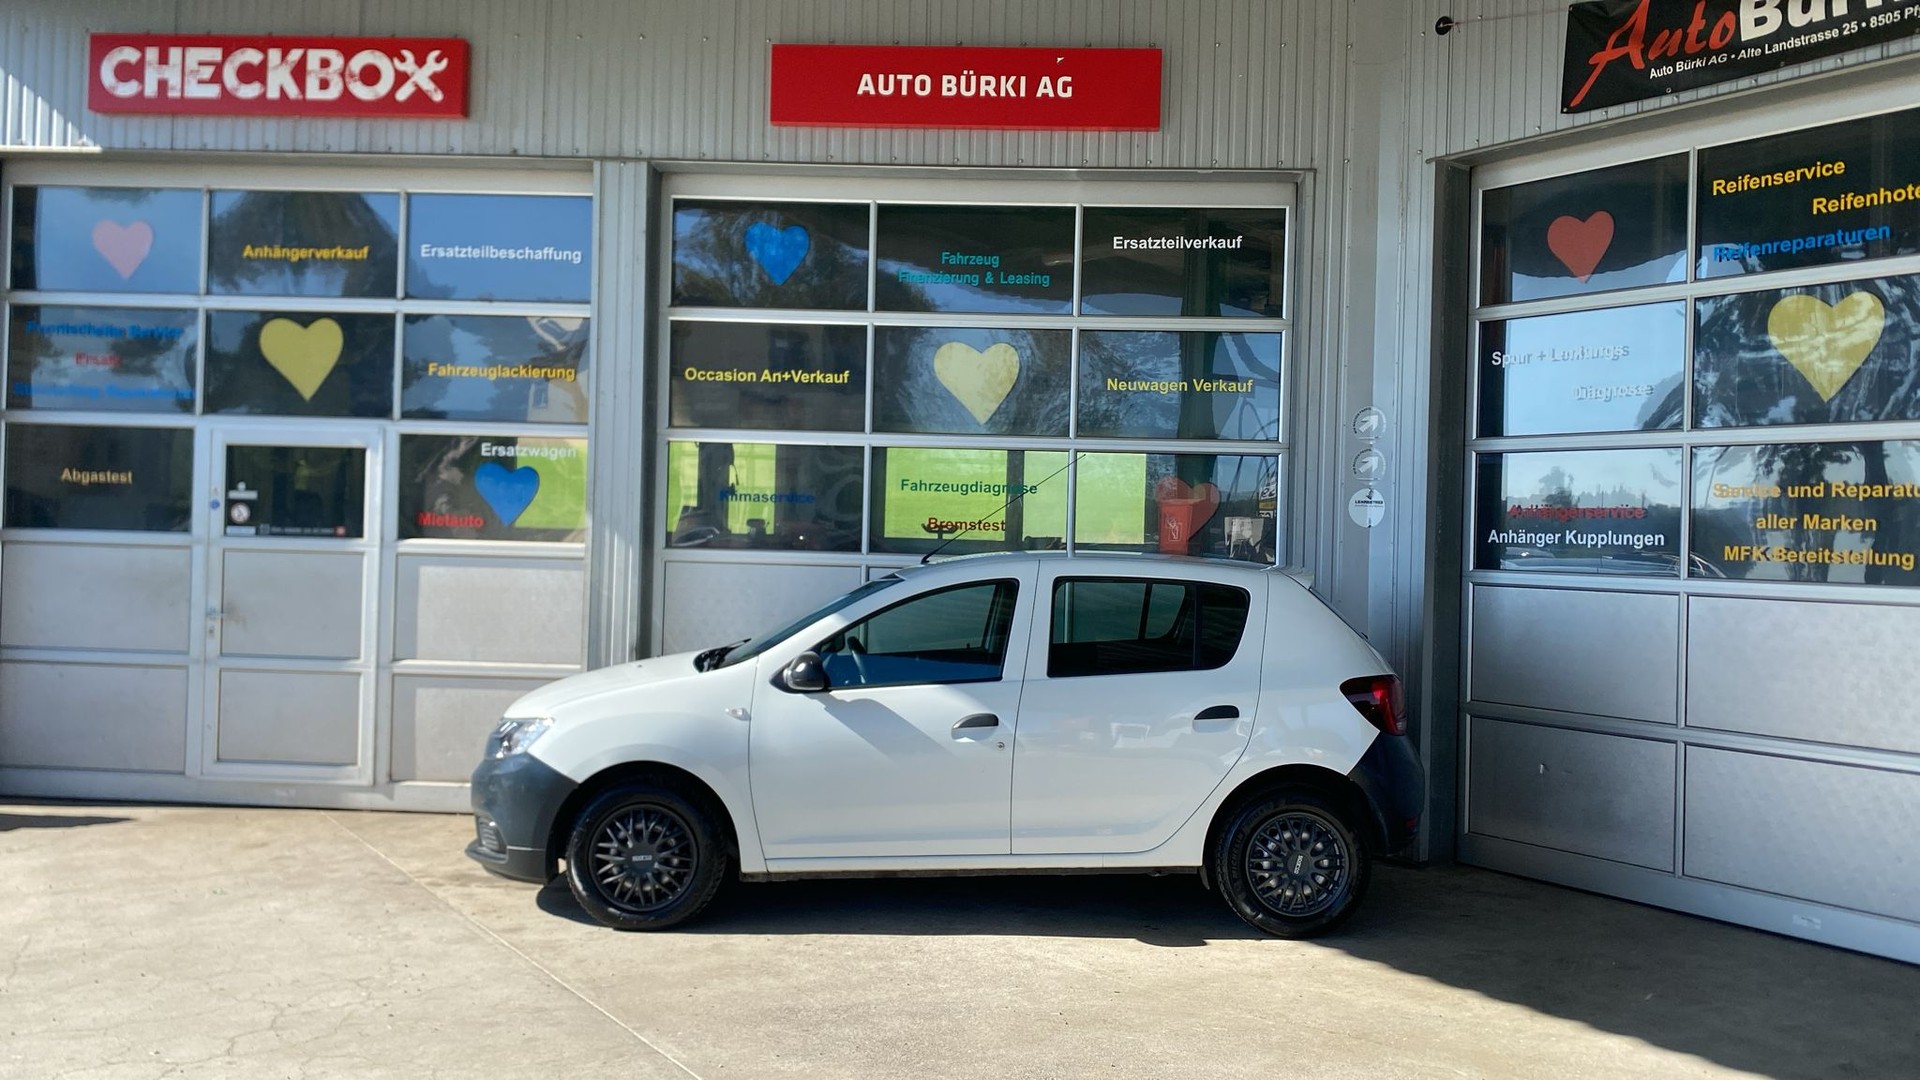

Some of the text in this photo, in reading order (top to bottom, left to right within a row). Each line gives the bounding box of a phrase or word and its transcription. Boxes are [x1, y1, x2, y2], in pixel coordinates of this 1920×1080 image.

[1649, 65, 1674, 79] Auto
[1676, 57, 1706, 72] Bürki
[1708, 53, 1728, 66] AG
[1737, 47, 1762, 60] Alte
[1764, 29, 1840, 55] Landstrasse
[1842, 21, 1858, 36] 25
[1870, 10, 1901, 28] 8505
[100, 45, 448, 102] CHECKBOX
[856, 70, 1073, 98] AUTO BÜRKI AG
[1712, 160, 1846, 196] Reifenservice
[1113, 235, 1243, 250] Ersatzteilverkauf
[1713, 225, 1891, 261] Reifenreparaturen
[242, 244, 369, 262] Anhängerverkauf
[420, 243, 582, 264] Ersatzteilbeschaffung
[941, 252, 1000, 268] Fahrzeug
[898, 271, 1050, 288] Finanzierung & Leasing
[428, 362, 576, 382] Fahrzeuglackierung
[684, 366, 850, 384] Occasion An+Verkauf
[1107, 378, 1253, 394] Neuwagen Verkauf
[481, 442, 577, 460] Ersatzwagen
[60, 467, 133, 485] Abgastest
[719, 488, 816, 504] Klimaservice
[900, 479, 1038, 496] Fahrzeugdiagnose
[1712, 482, 1781, 498] Service
[1787, 482, 1824, 498] und
[418, 511, 485, 528] Mietauto
[1508, 504, 1648, 523] Anhängerservice
[1756, 514, 1877, 531] aller Marken
[927, 517, 1006, 532] Bremstest
[1488, 529, 1665, 549] Anhänger Kupplungen
